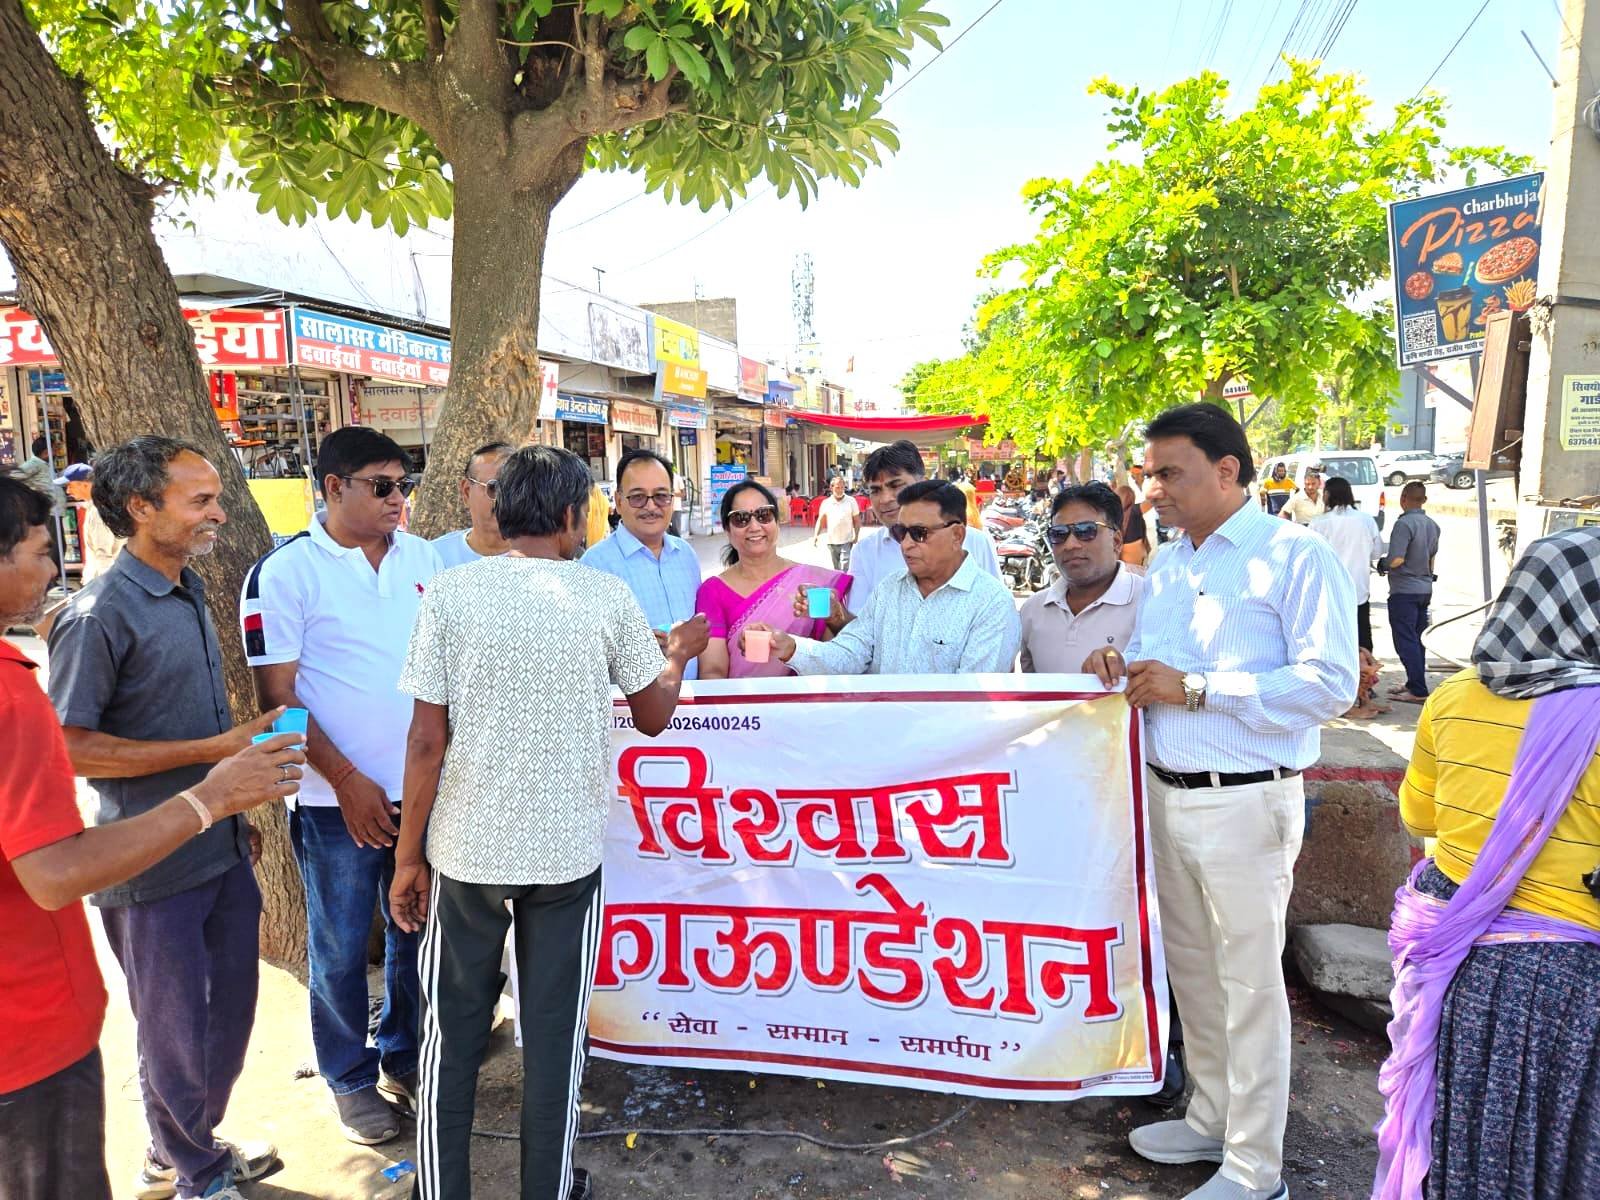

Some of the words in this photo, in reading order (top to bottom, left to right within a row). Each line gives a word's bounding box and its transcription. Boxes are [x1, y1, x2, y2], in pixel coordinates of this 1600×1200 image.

[1463, 189, 1538, 216] Charbhuja
[1400, 207, 1536, 265] Pizza
[299, 316, 376, 349] सालासर
[300, 345, 361, 369] दवाईयां
[617, 745, 1014, 864] विश्वास
[766, 1023, 848, 1045] सम्मान
